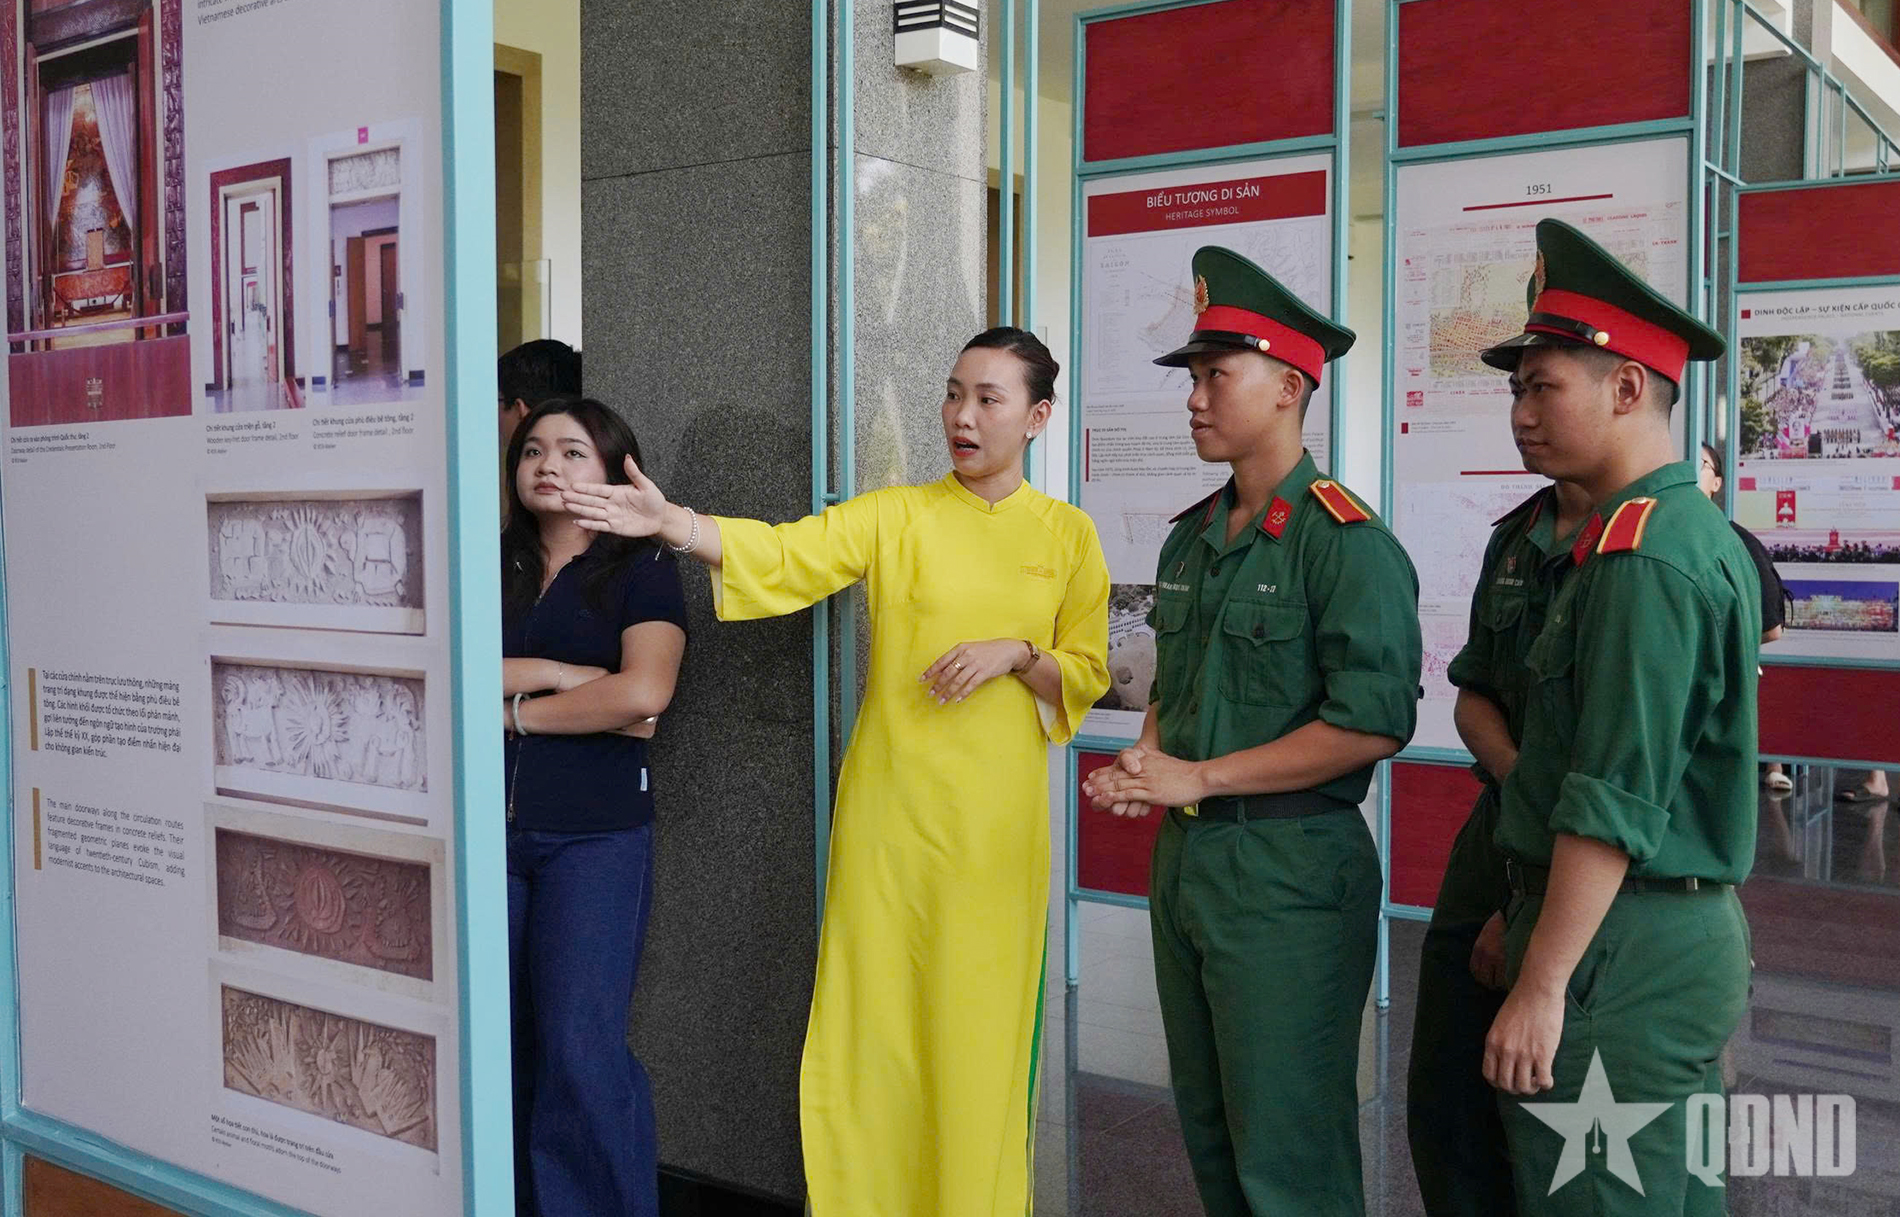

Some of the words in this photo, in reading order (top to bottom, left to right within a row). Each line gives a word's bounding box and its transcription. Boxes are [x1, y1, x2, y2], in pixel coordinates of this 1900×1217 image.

[198, 9, 234, 25] Vietnamese
[235, 0, 268, 15] decorative
[1147, 191, 1172, 208] BIỂU
[1175, 190, 1217, 205] TƯỢNG
[1222, 188, 1232, 200] DI
[1236, 182, 1260, 198] SẢN
[1526, 184, 1552, 195] 1951
[1166, 209, 1203, 220] HERITAGE
[1206, 206, 1240, 217] SYMBOL
[47, 798, 56, 808] The
[59, 802, 72, 810] main
[75, 804, 100, 816] doorways
[103, 808, 117, 820] along
[120, 811, 130, 820] the
[133, 814, 161, 826] circulation
[165, 820, 184, 830] routes
[48, 812, 65, 824] feature
[67, 817, 94, 829] decorative
[95, 821, 114, 832] frames
[116, 825, 121, 833] in
[122, 827, 146, 839] concrete
[148, 831, 166, 842] reliefs.
[169, 833, 184, 844] Their
[48, 826, 77, 840] fragmented
[81, 834, 107, 846] geometric
[111, 839, 129, 851] planes
[133, 844, 150, 854] evoke
[154, 846, 164, 857] the
[168, 850, 185, 860] visual
[48, 842, 71, 855] language
[75, 845, 81, 855] of
[86, 849, 132, 867] twentieth-century
[48, 856, 74, 868] modernist
[74, 861, 94, 872] accents
[94, 865, 100, 873] to
[101, 866, 110, 875] the
[111, 868, 144, 883] architectural
[145, 875, 164, 886] spaces.
